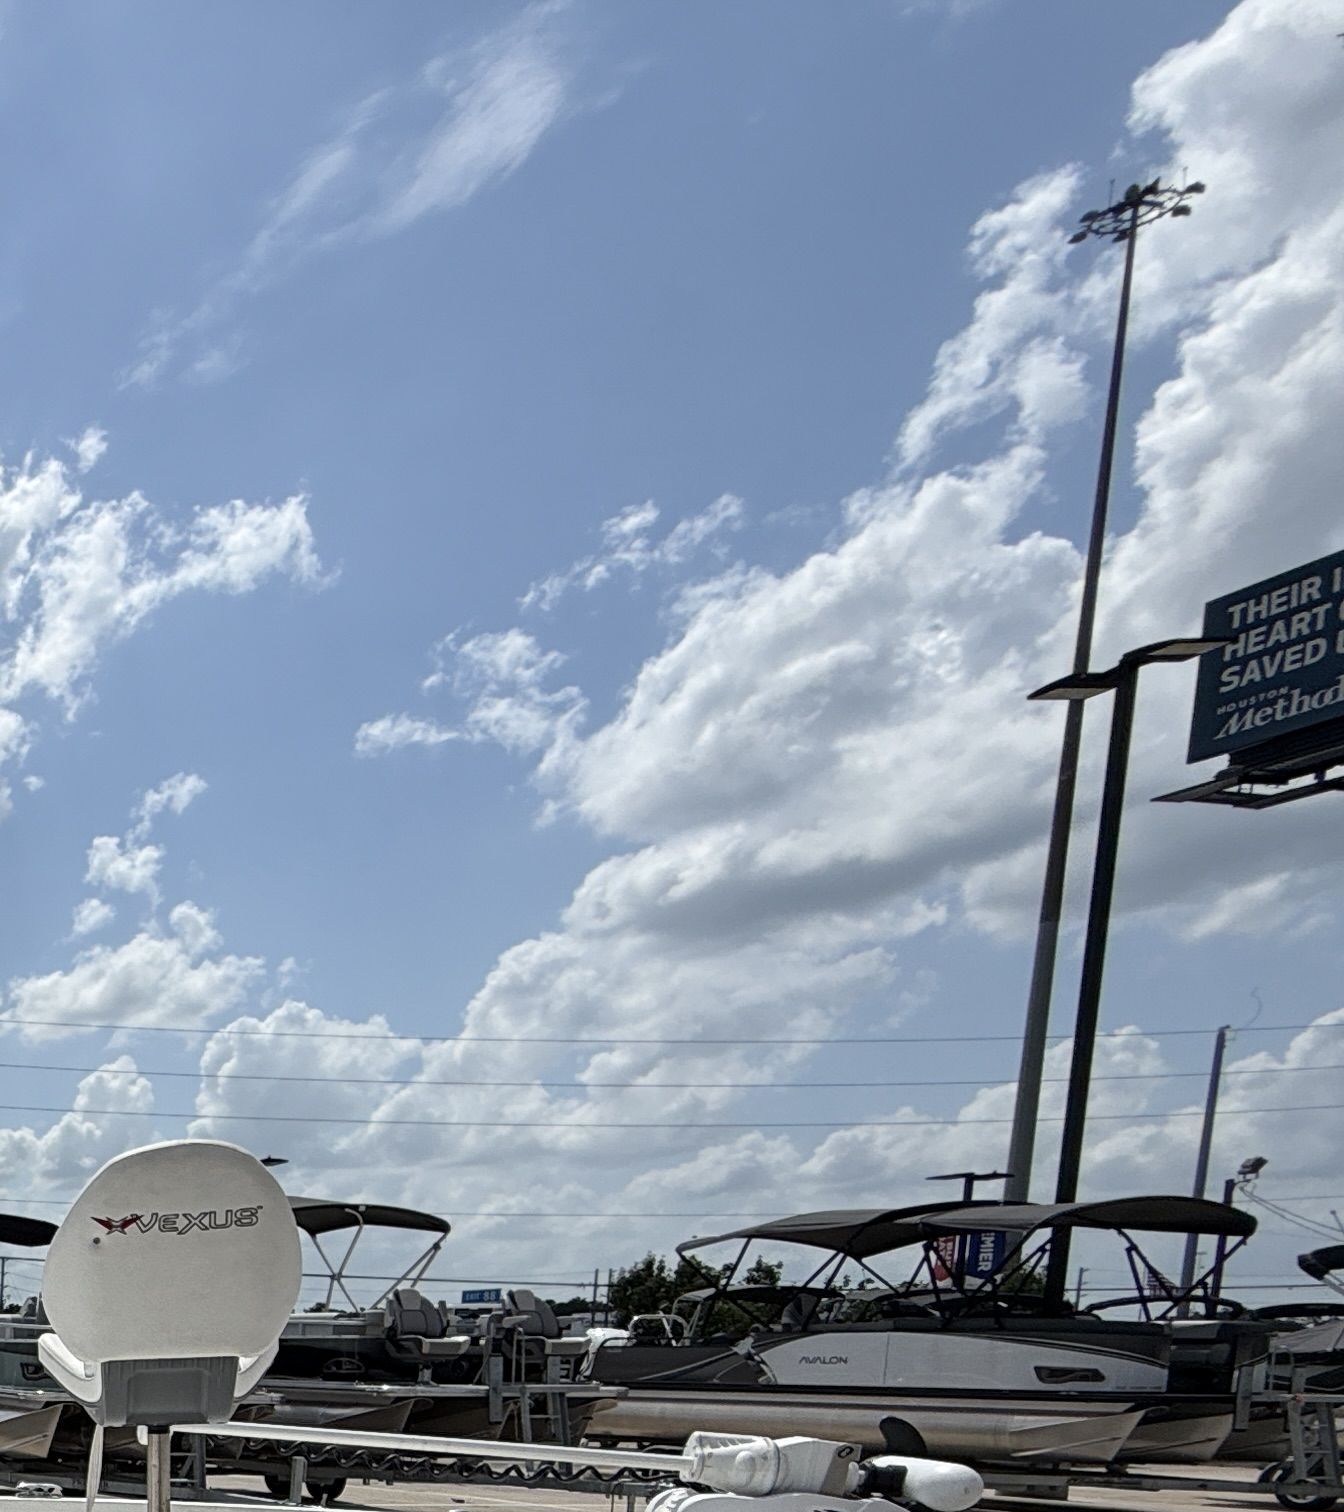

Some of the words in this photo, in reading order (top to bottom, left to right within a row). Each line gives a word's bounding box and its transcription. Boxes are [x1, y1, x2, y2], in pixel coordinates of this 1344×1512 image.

[1228, 575, 1322, 629] THEIR
[1223, 603, 1332, 662] HEART
[1219, 637, 1327, 694] SAVED
[1216, 686, 1289, 715] HOUSTON
[130, 1206, 259, 1235] VEXUS
[798, 1356, 848, 1365] AVALON
